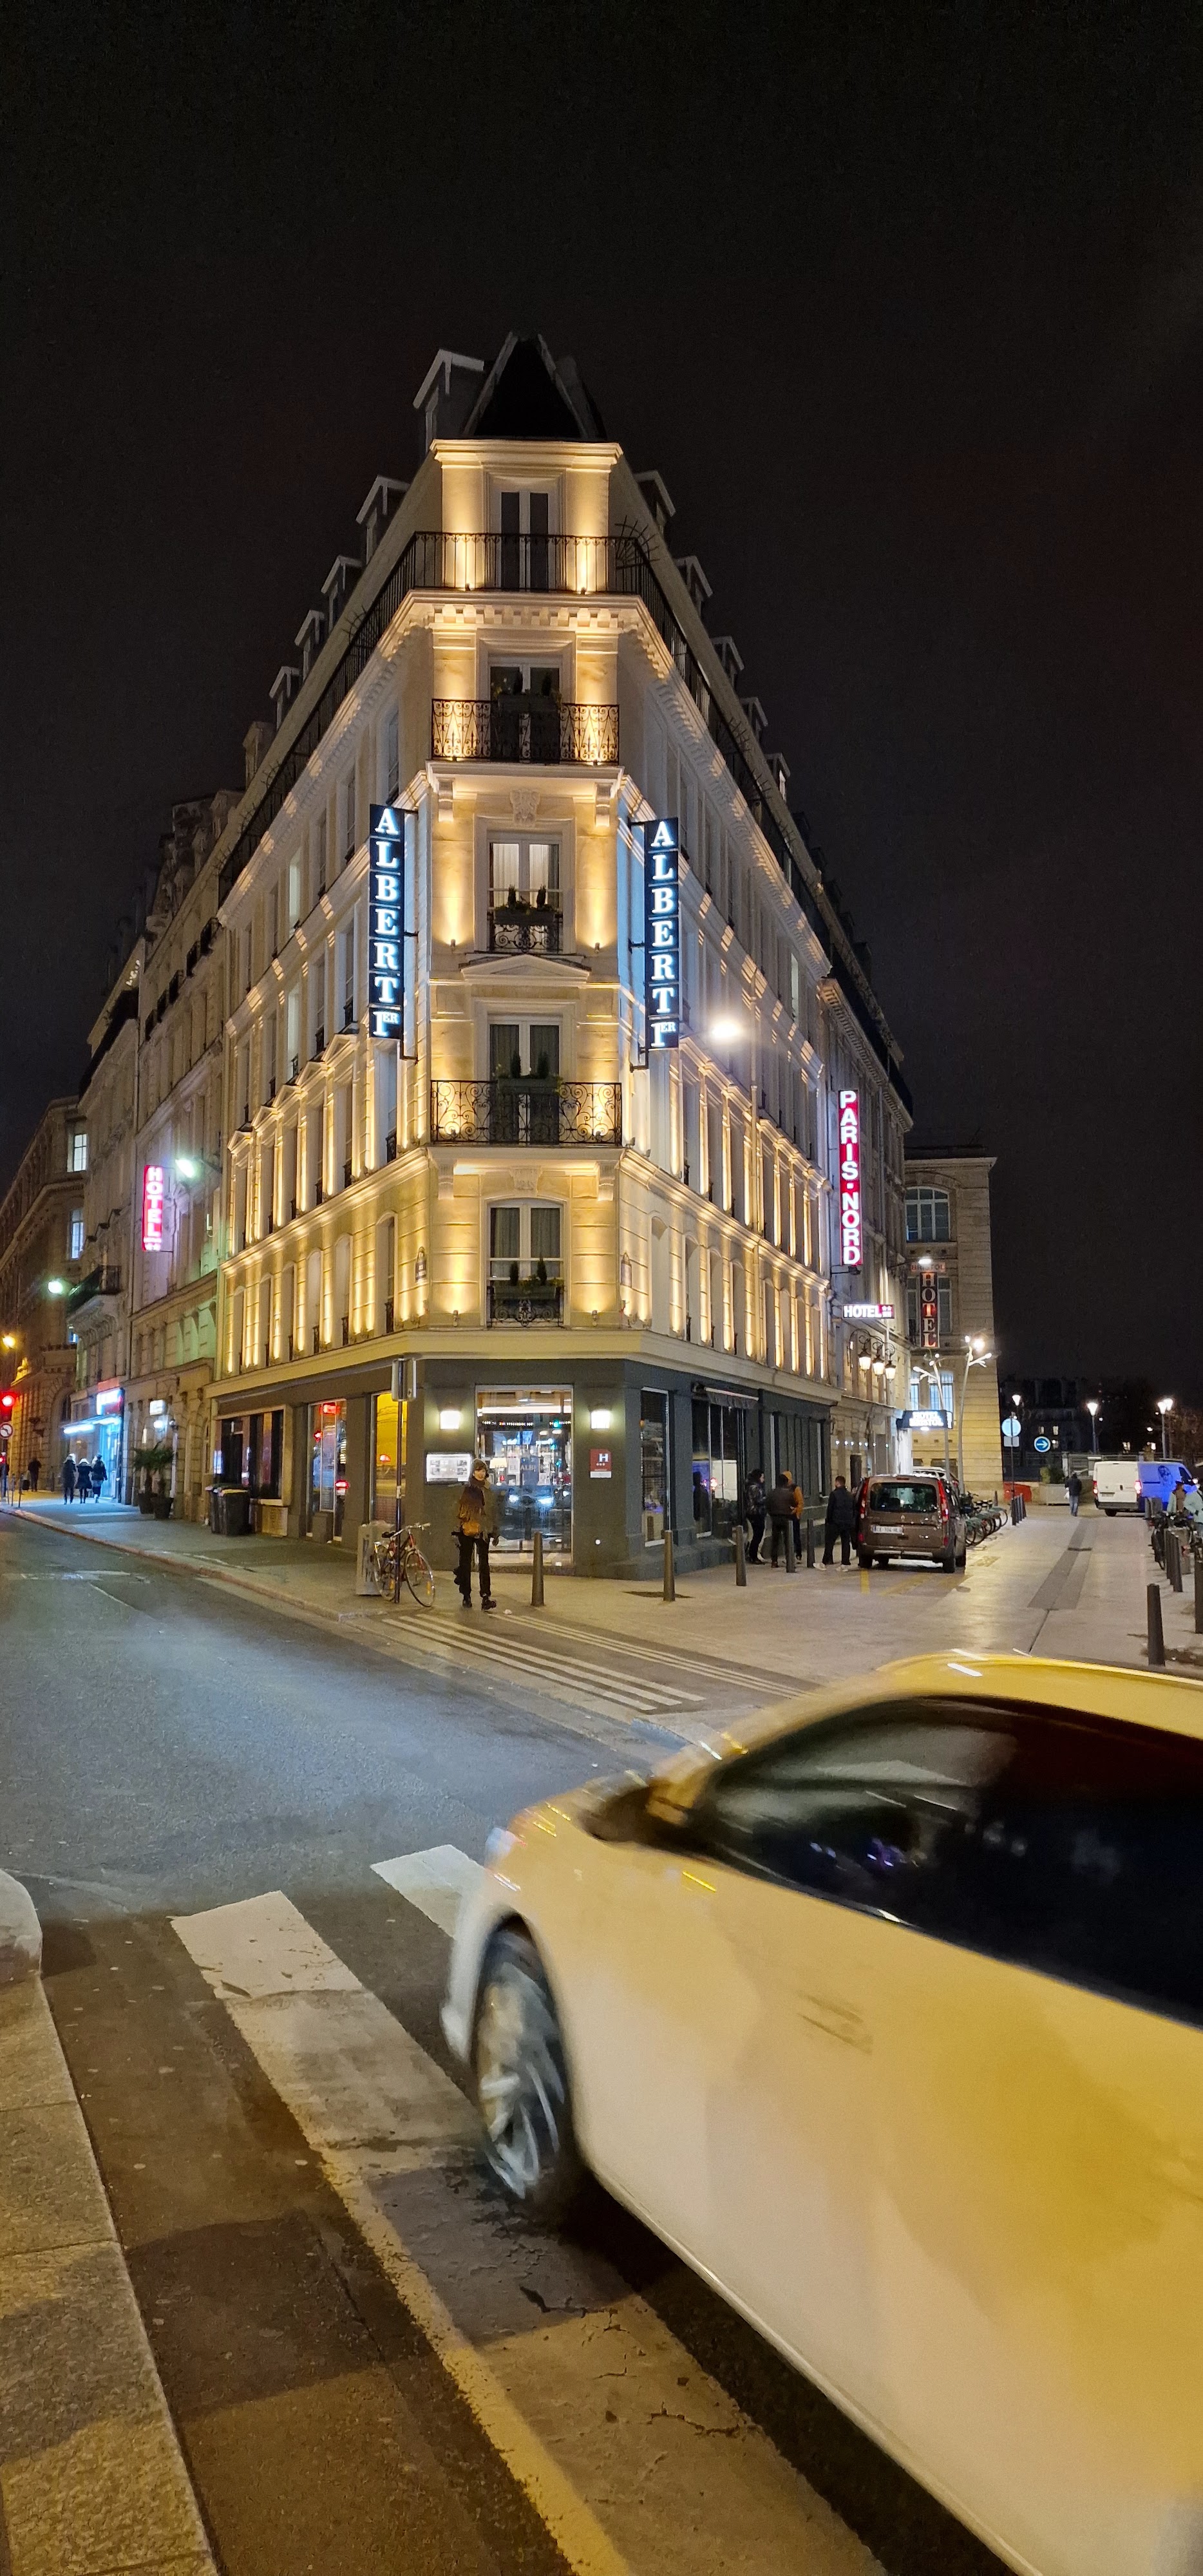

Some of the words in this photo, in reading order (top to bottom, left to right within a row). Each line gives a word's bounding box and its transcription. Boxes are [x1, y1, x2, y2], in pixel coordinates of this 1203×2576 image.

[375, 808, 399, 1003] ALBERT
[651, 821, 675, 1014] ALBERT
[146, 1166, 163, 1236] HOTEL
[843, 1305, 882, 1318] HOTEL
[922, 1273, 936, 1347] HOTEL
[599, 1453, 609, 1463] H
